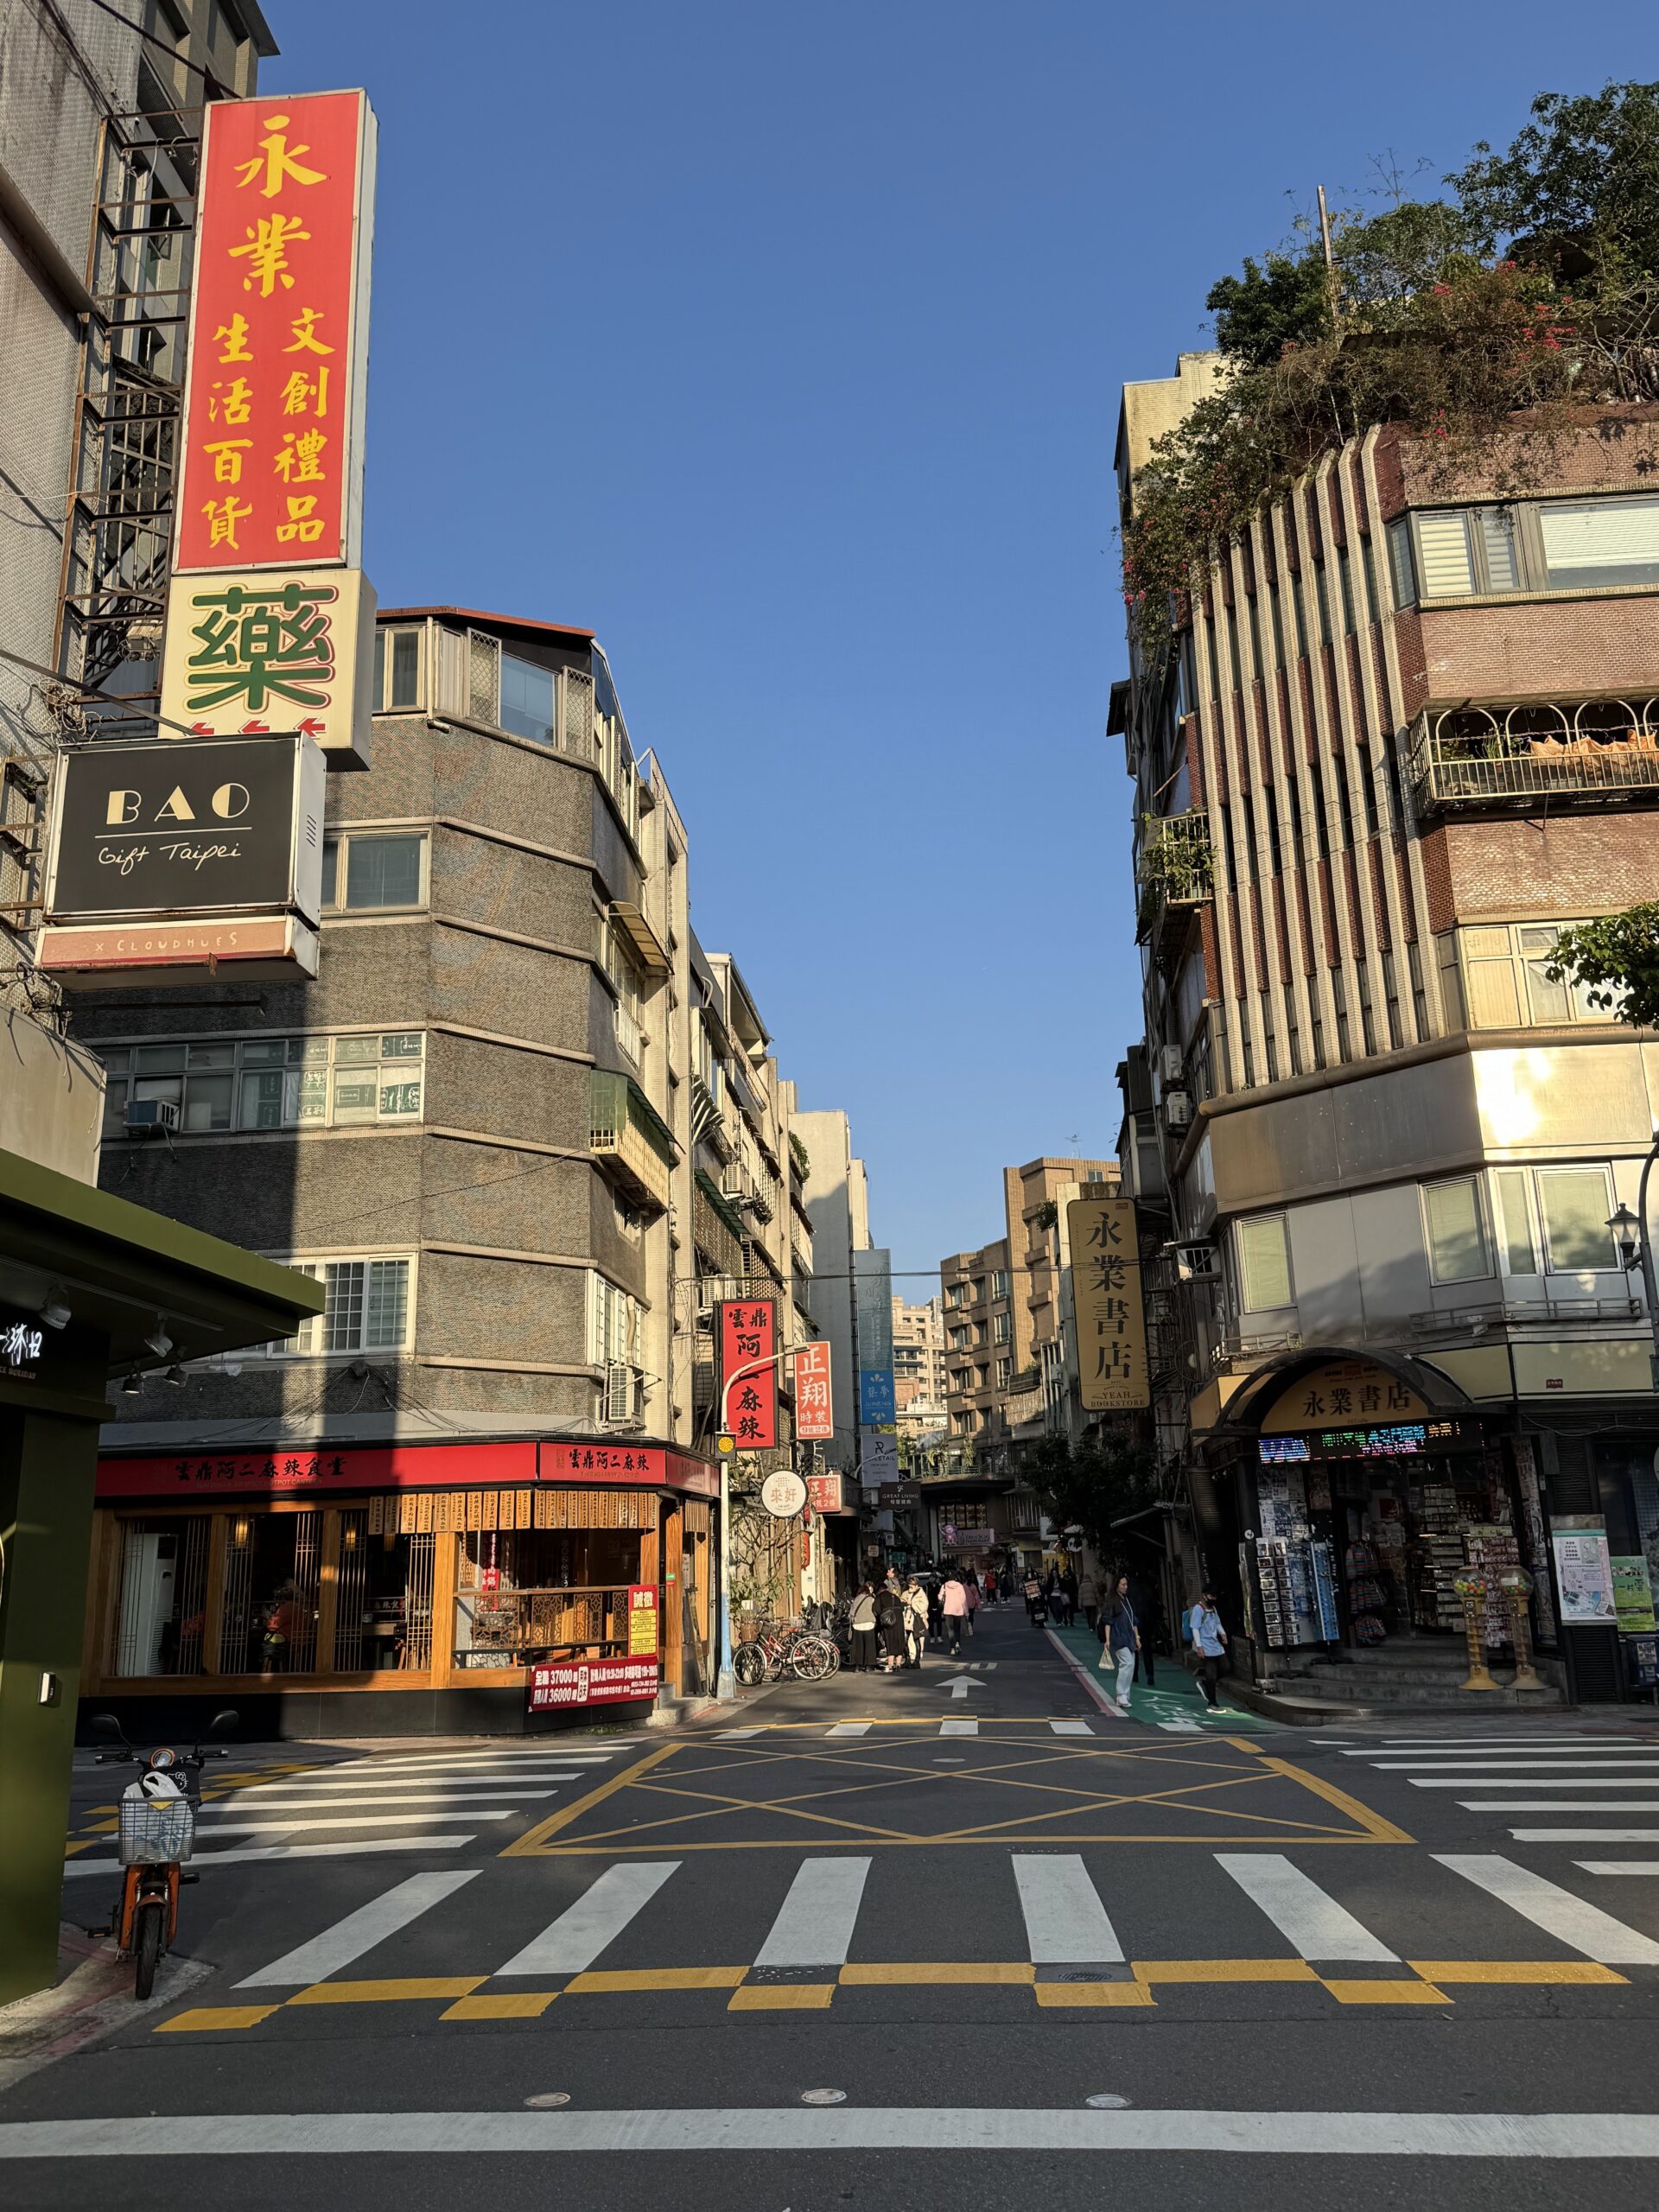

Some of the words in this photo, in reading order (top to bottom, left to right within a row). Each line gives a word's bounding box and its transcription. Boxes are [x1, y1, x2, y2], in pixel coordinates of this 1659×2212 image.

[228, 115, 327, 298] 永業
[202, 312, 254, 550] 生活百貨
[274, 307, 335, 543] 文創禮品
[187, 582, 339, 713] 藥
[105, 782, 251, 825] BAO
[98, 847, 148, 876] Gift
[159, 842, 242, 871] Taipei
[117, 931, 238, 952] CLOUDHUES
[1085, 1211, 1132, 1380] 永業書店
[728, 1307, 767, 1328] 雲鼎
[798, 1345, 828, 1409] 正翔
[1303, 1382, 1411, 1417] 永業書店
[800, 1411, 828, 1424] 時裝
[175, 1456, 347, 1481] 雲鼎阿二麻辣食堂
[569, 1448, 650, 1471] 雲鼎阿二麻辣
[770, 1487, 797, 1503] 來好
